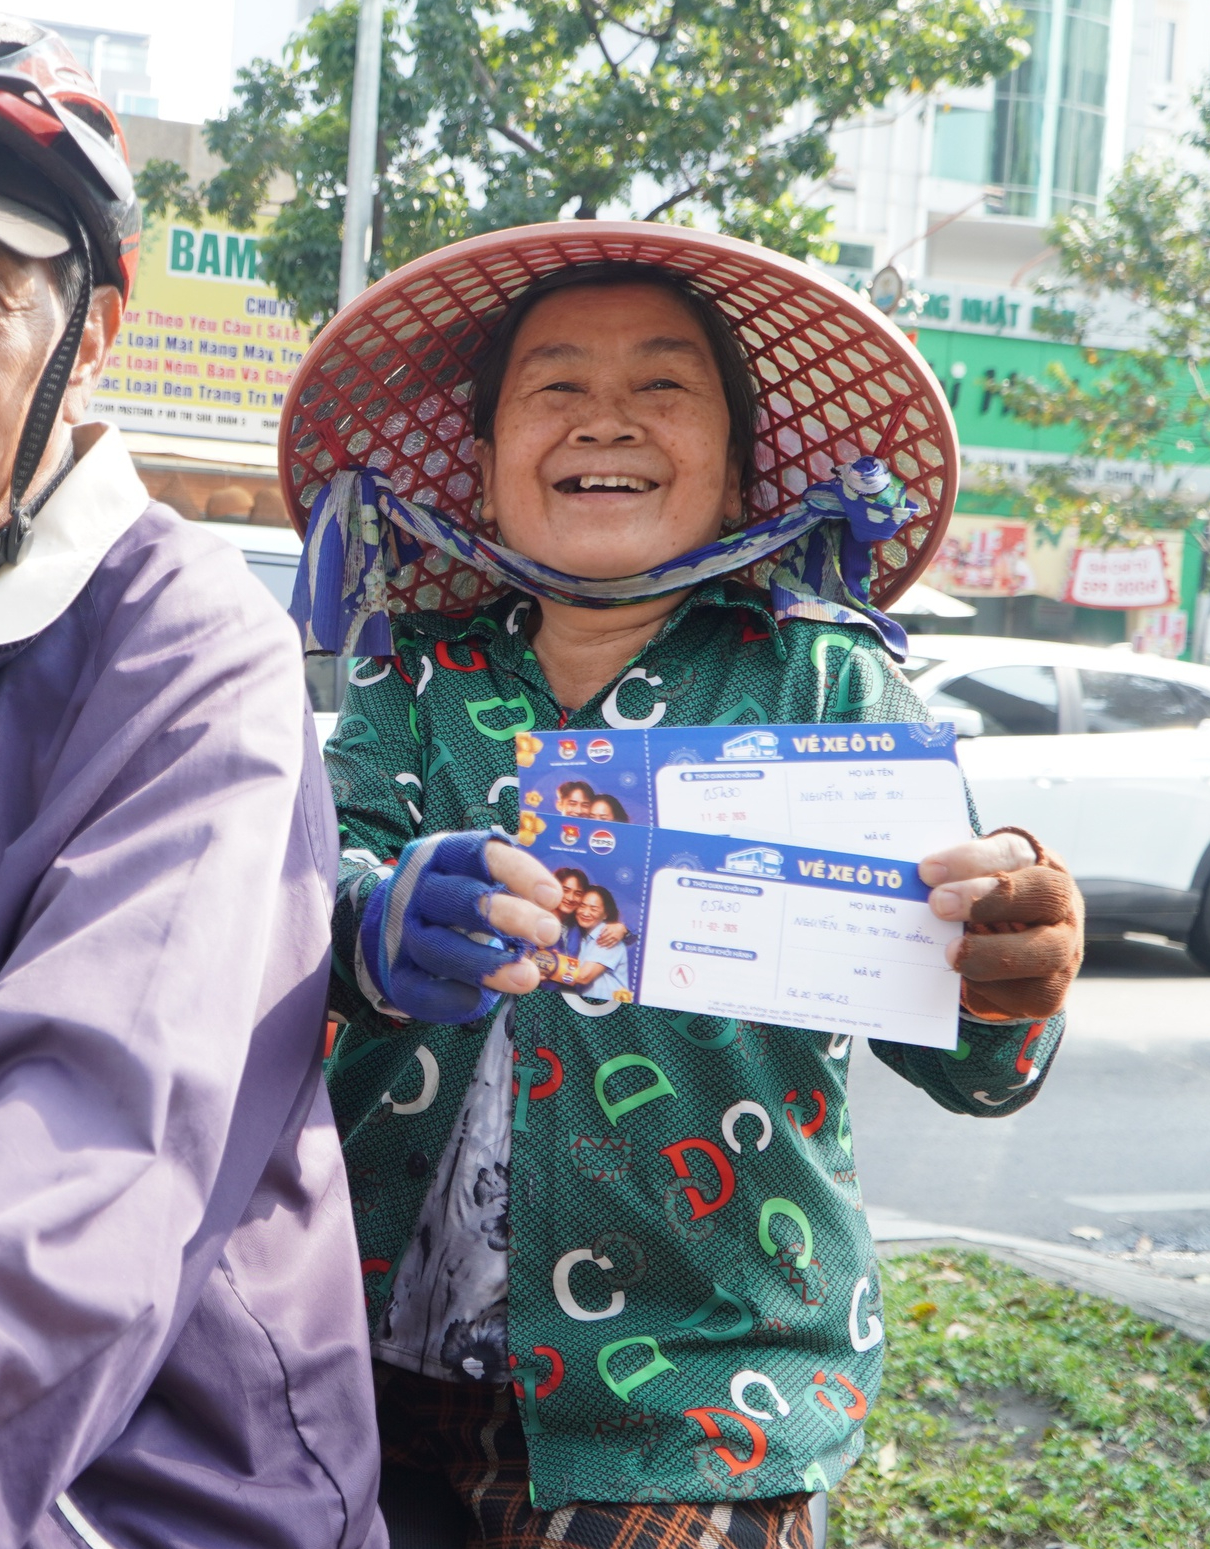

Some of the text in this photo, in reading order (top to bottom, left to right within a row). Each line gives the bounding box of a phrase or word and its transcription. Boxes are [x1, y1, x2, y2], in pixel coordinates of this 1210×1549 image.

[170, 227, 264, 282] BAM
[147, 311, 184, 329] Theo
[199, 382, 242, 405] Trang
[793, 733, 896, 754] VÉ XE Ô TÔ
[877, 768, 894, 777] TÊN
[591, 838, 615, 848] PEPSI
[864, 832, 877, 841] MÃ
[797, 859, 903, 889] VÉ XE Ô TÔ
[879, 904, 896, 914] TÊN
[853, 966, 867, 976] MÃ
